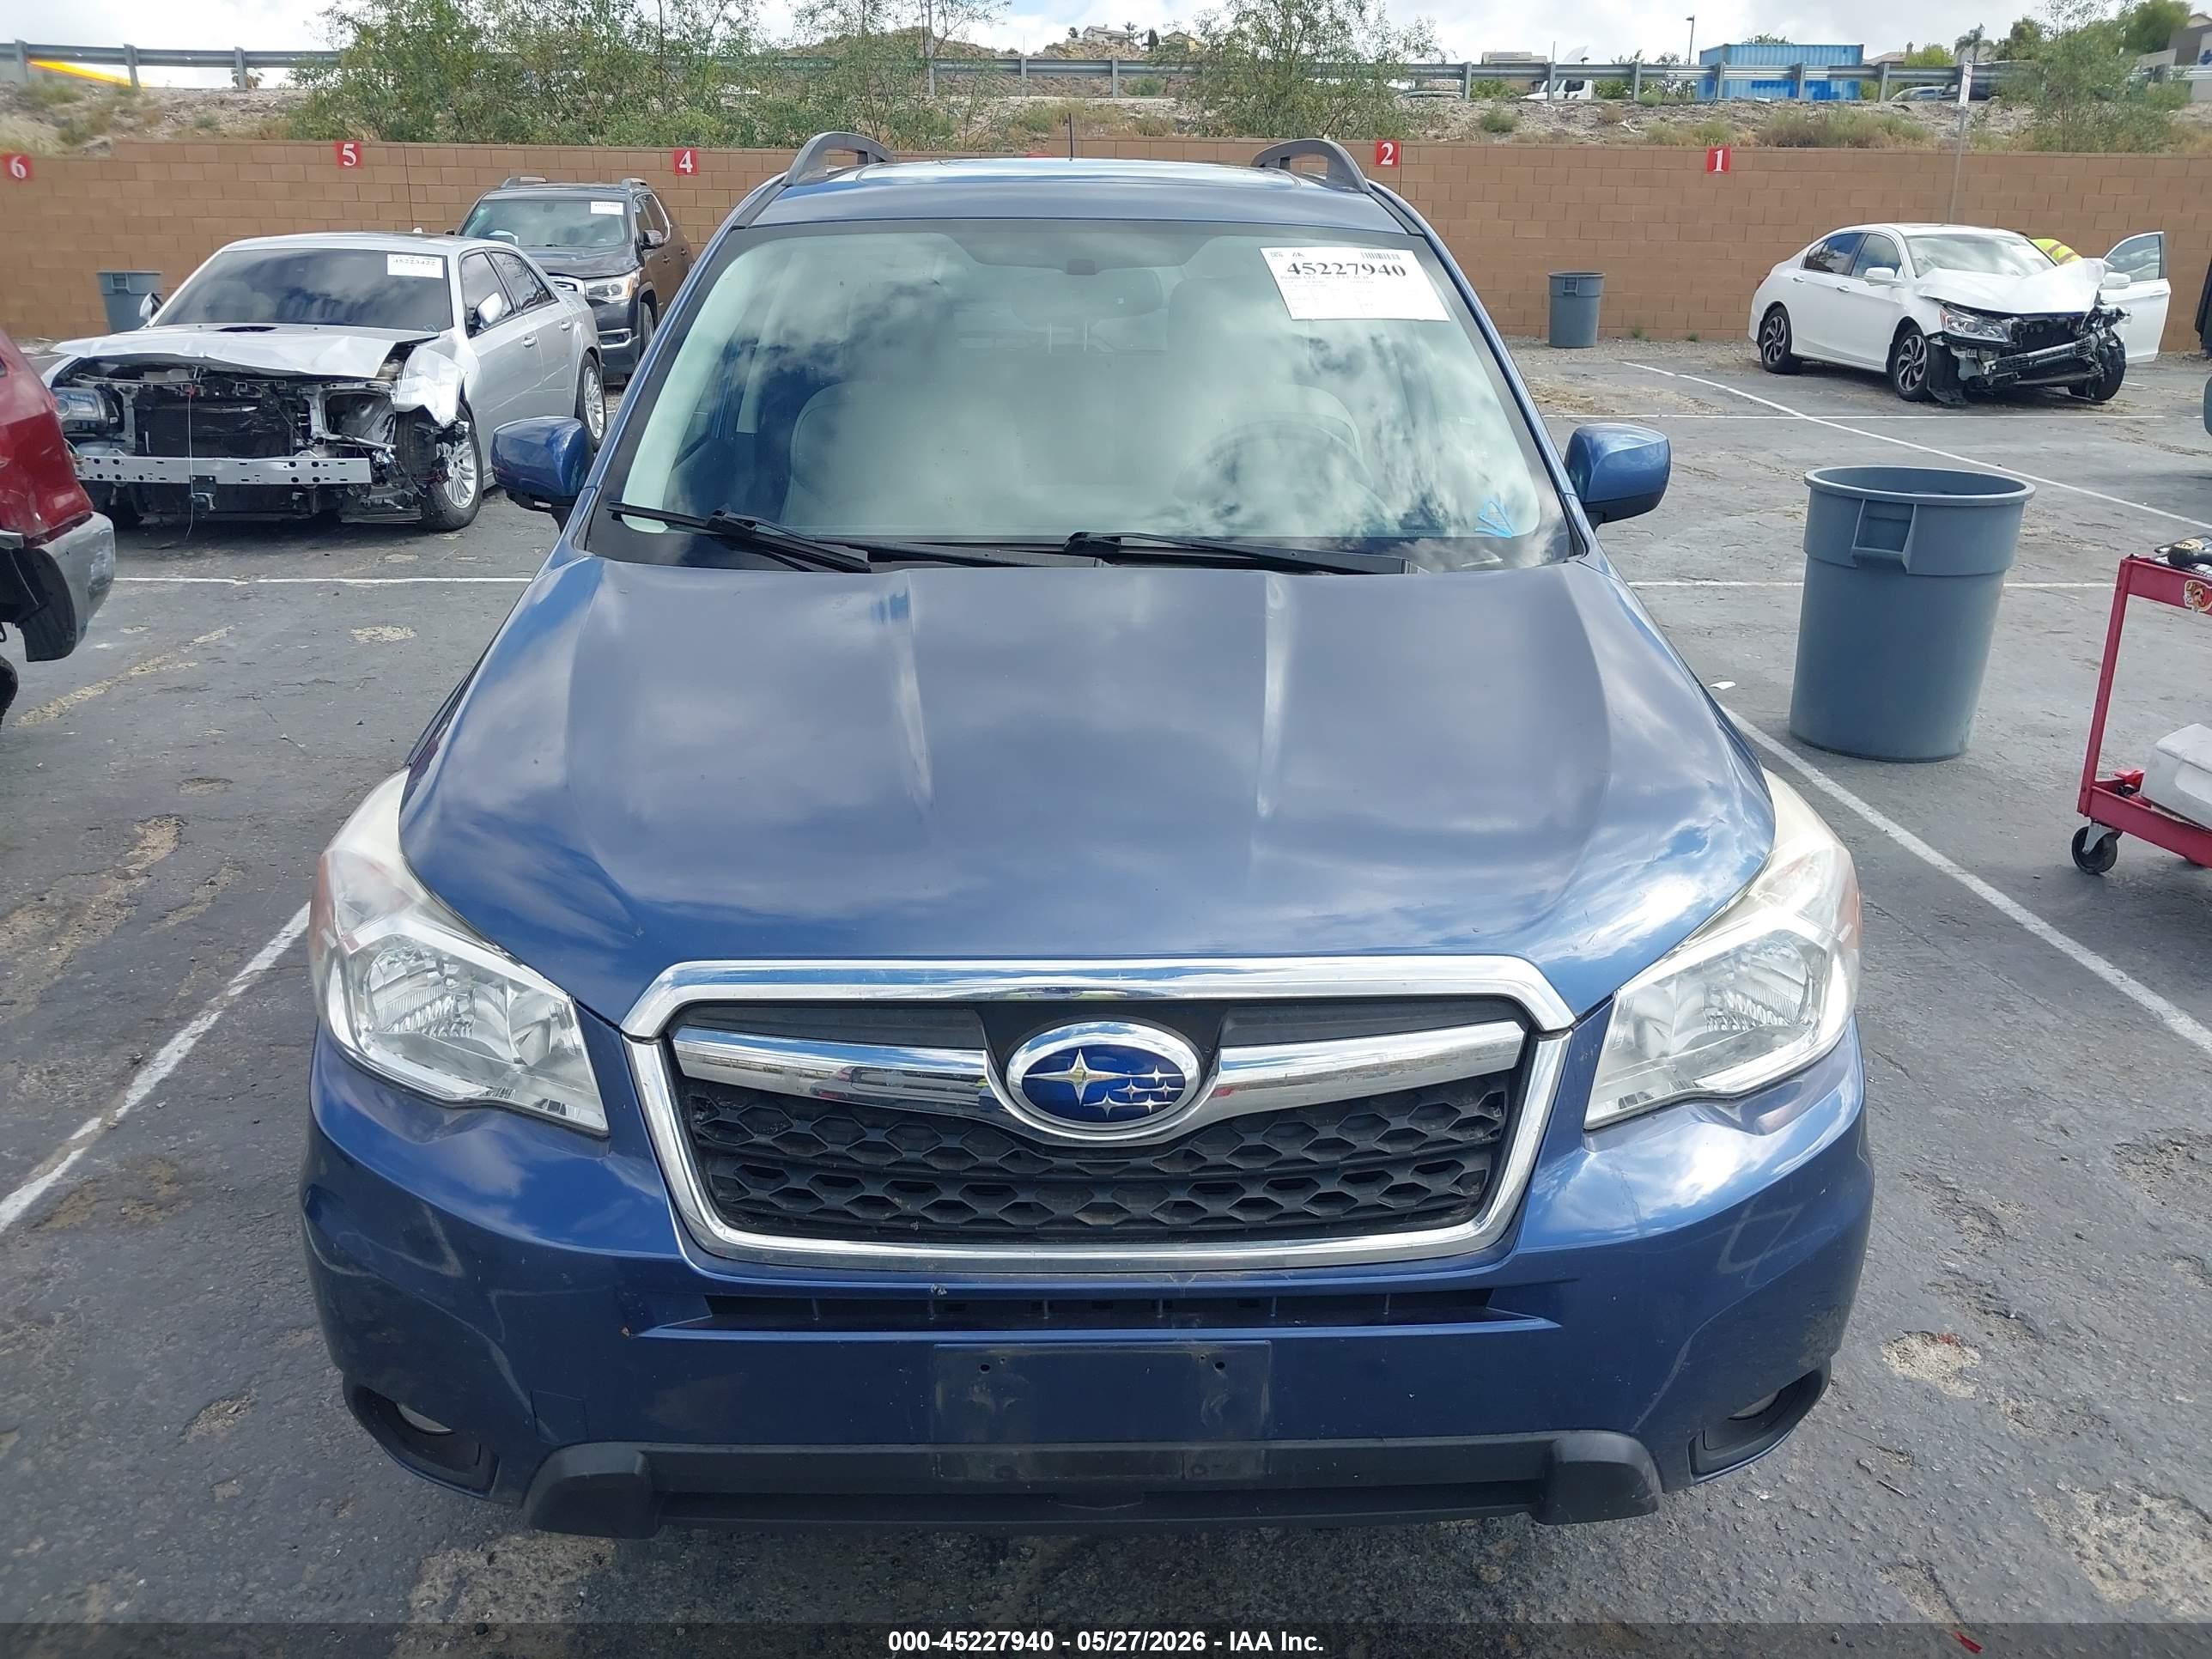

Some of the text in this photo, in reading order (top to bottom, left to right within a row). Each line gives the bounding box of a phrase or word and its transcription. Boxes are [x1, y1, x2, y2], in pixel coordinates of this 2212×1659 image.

[343, 143, 356, 166] 5
[678, 150, 693, 173] 4
[1381, 143, 1394, 165] 2
[1713, 149, 1724, 171] 1
[10, 155, 27, 179] 6
[1286, 262, 1407, 276] 45227940
